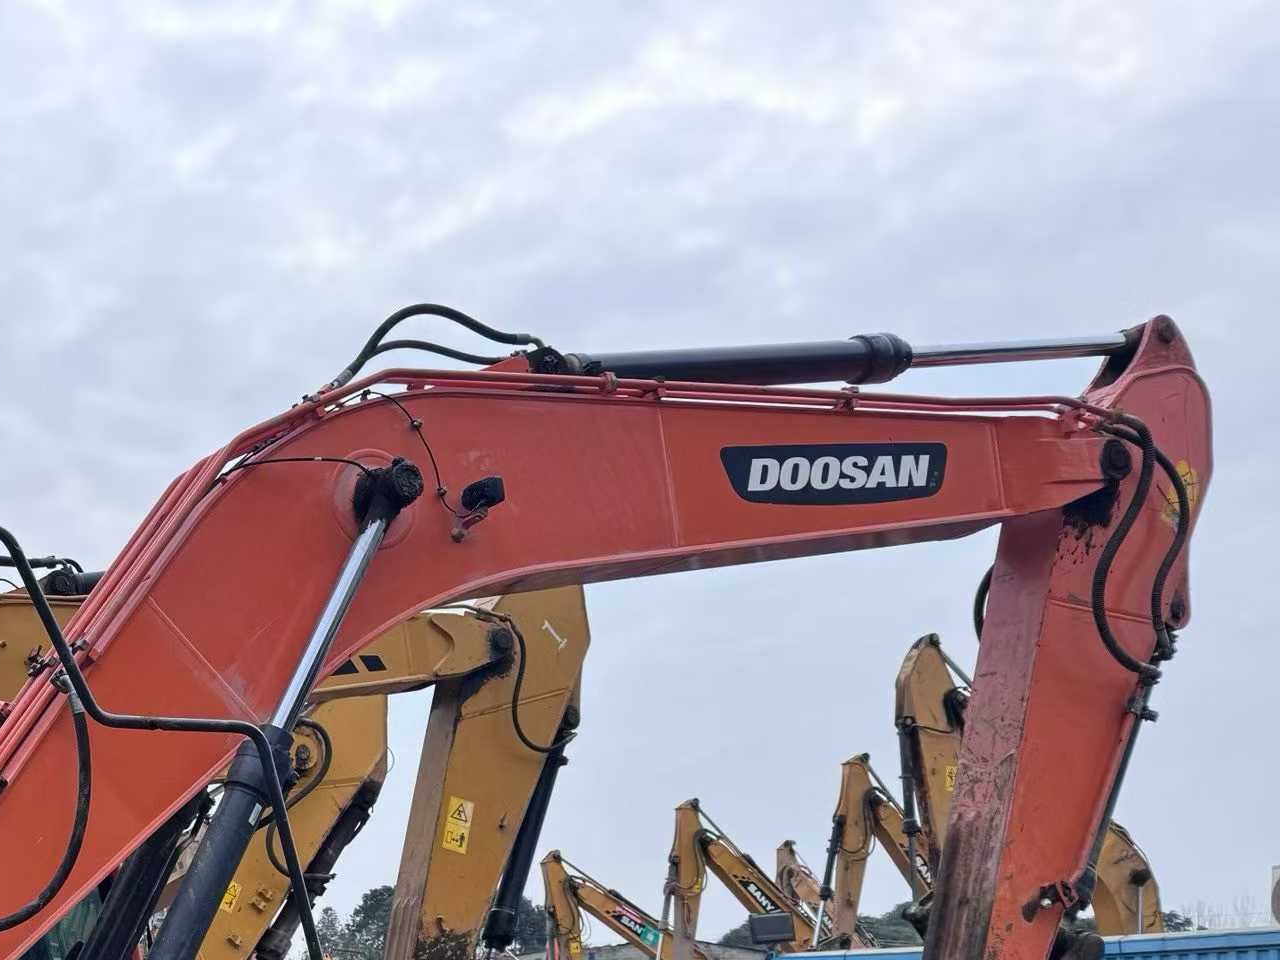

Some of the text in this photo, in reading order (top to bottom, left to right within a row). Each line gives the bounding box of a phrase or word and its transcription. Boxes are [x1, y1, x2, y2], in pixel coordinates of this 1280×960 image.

[747, 454, 931, 492] DOOSAN
[914, 855, 932, 883] SAN
[747, 883, 775, 911] SANY
[620, 915, 643, 934] SAN
